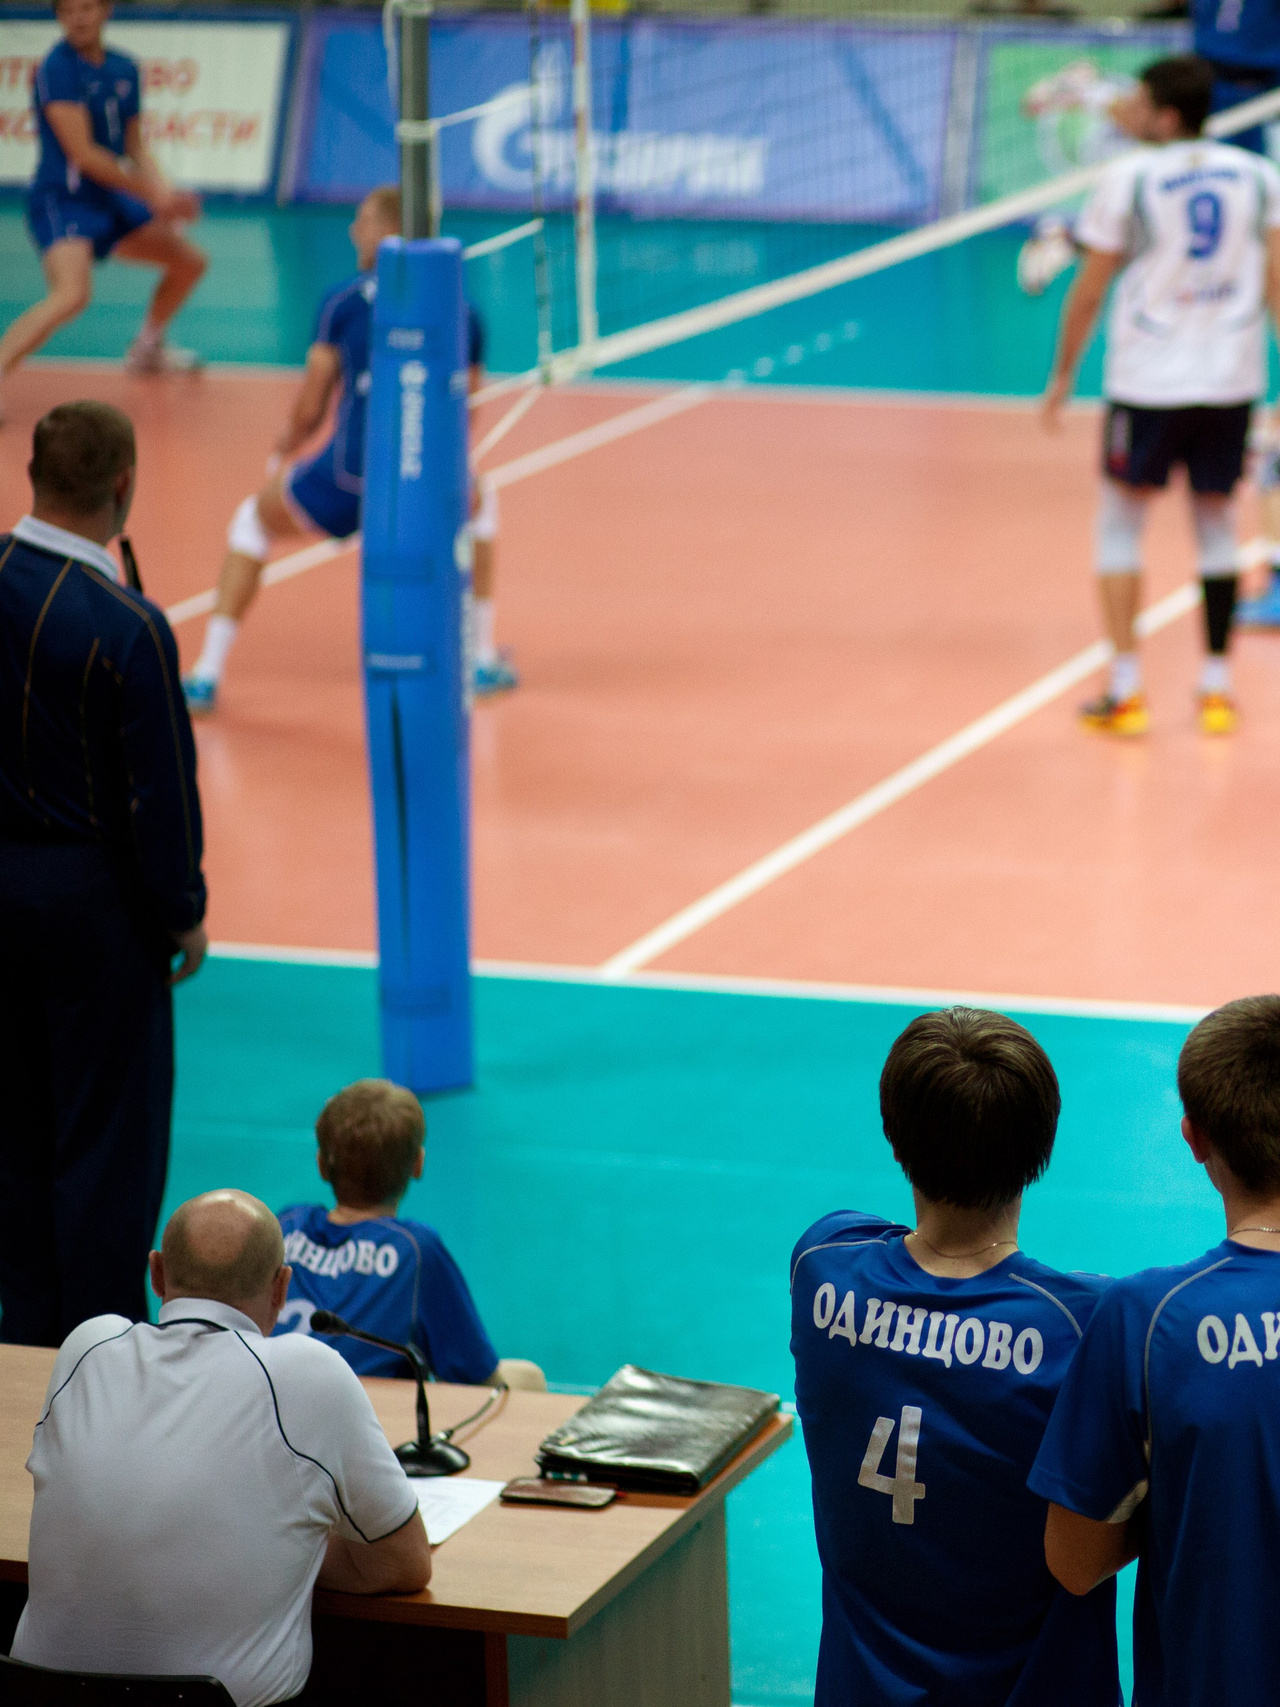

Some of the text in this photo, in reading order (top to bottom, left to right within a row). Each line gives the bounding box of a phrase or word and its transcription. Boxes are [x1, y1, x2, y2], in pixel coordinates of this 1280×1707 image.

[1187, 190, 1224, 261] 9
[283, 1230, 399, 1279] ИНЦОВО
[813, 1282, 1044, 1375] ОДИНЦОВО
[857, 1405, 926, 1525] 4
